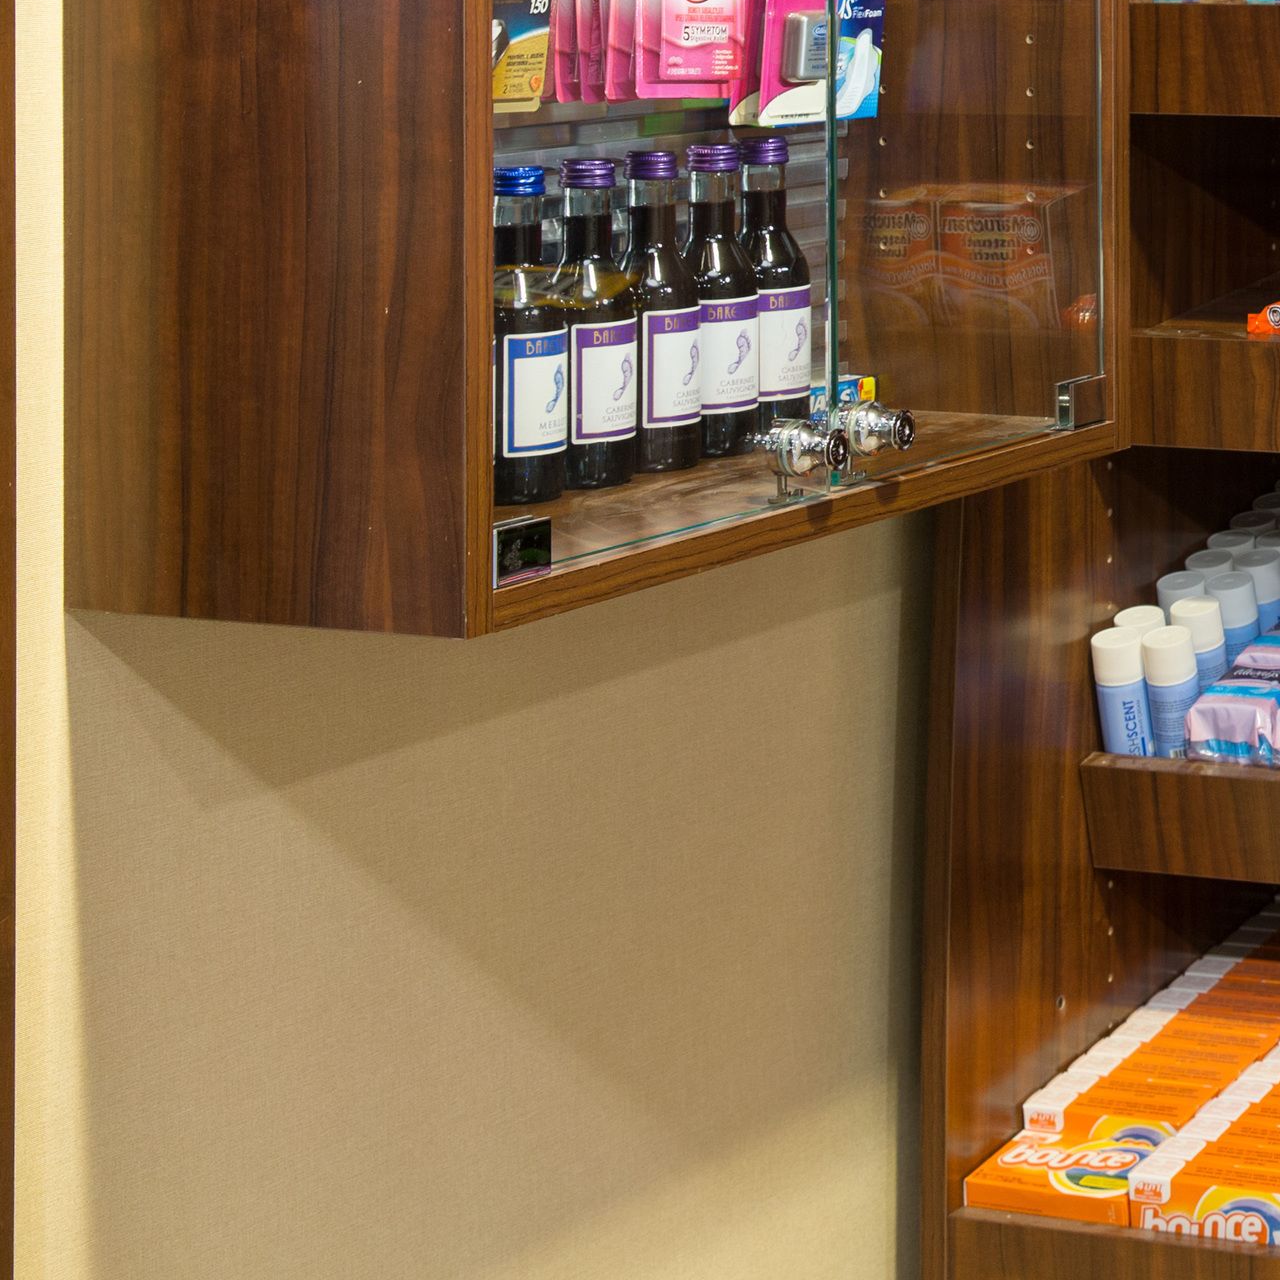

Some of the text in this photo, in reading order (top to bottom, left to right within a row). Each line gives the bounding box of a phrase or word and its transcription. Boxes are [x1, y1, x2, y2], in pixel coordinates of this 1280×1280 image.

[683, 26, 727, 42] 5 SYMPTOM
[1002, 1145, 1137, 1168] bounce
